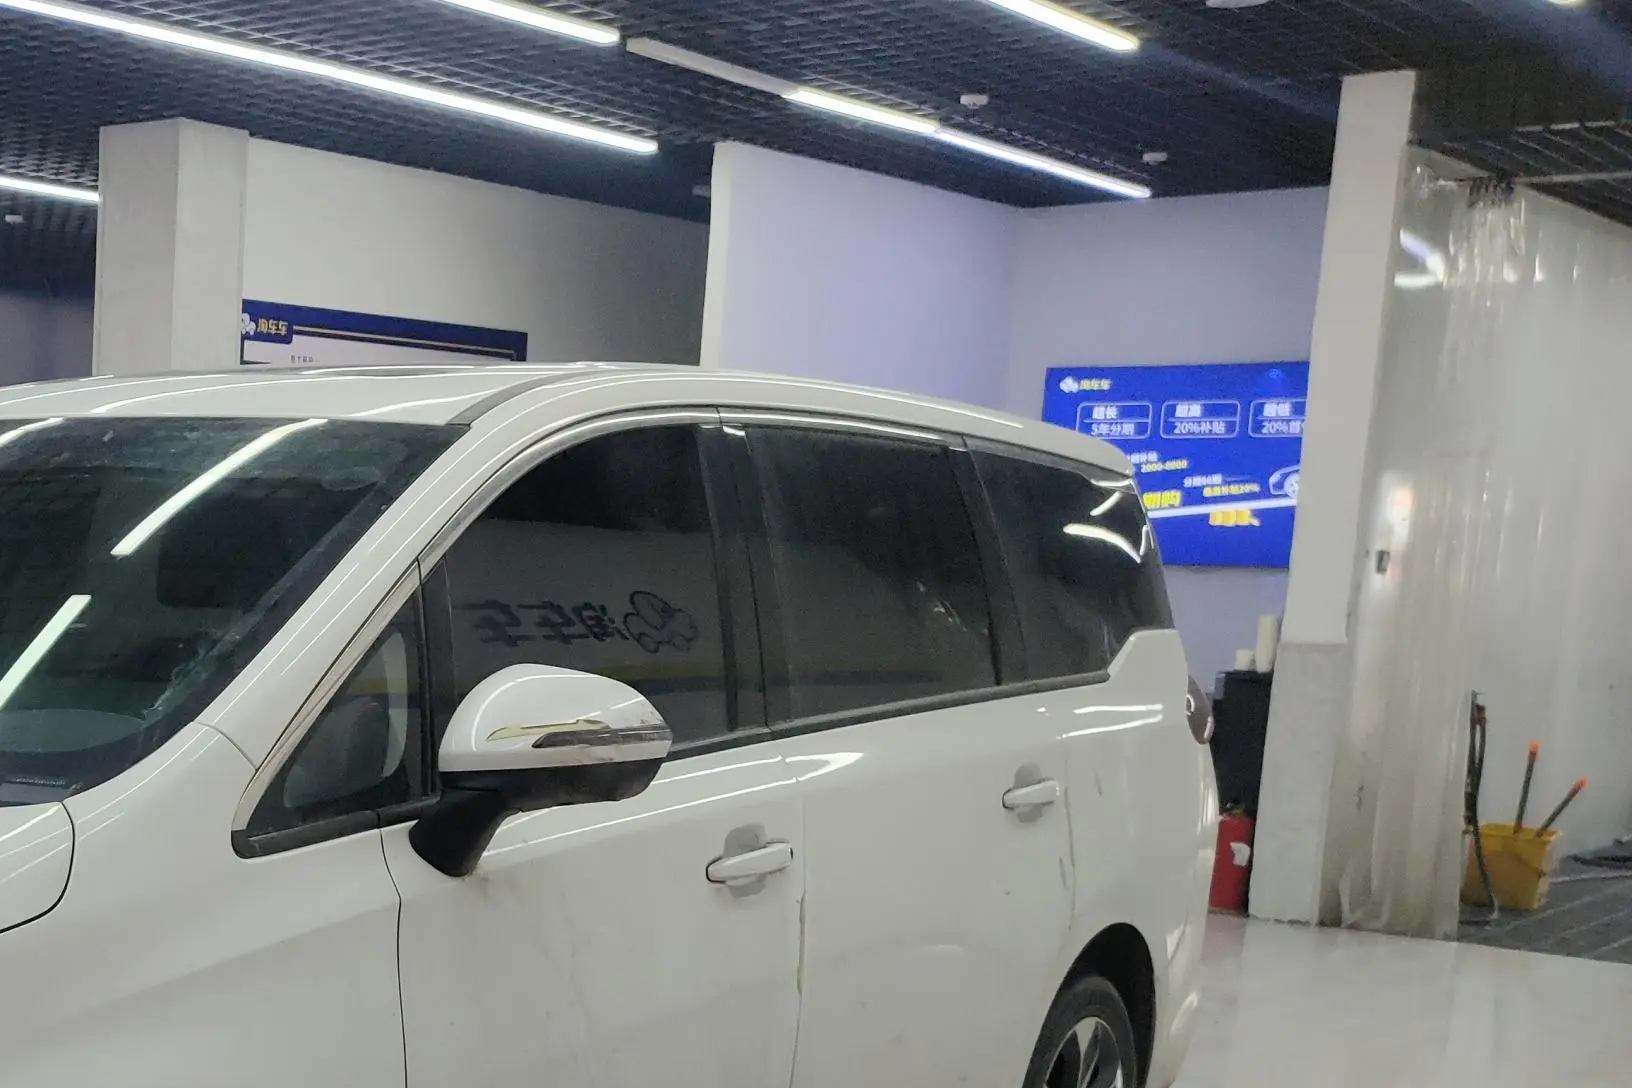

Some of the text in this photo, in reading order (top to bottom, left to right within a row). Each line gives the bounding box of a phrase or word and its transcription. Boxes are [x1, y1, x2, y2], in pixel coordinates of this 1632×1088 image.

[1092, 405, 1118, 420] 超长
[1091, 423, 1135, 436] 5年分期
[1174, 421, 1225, 434] 20%补贴
